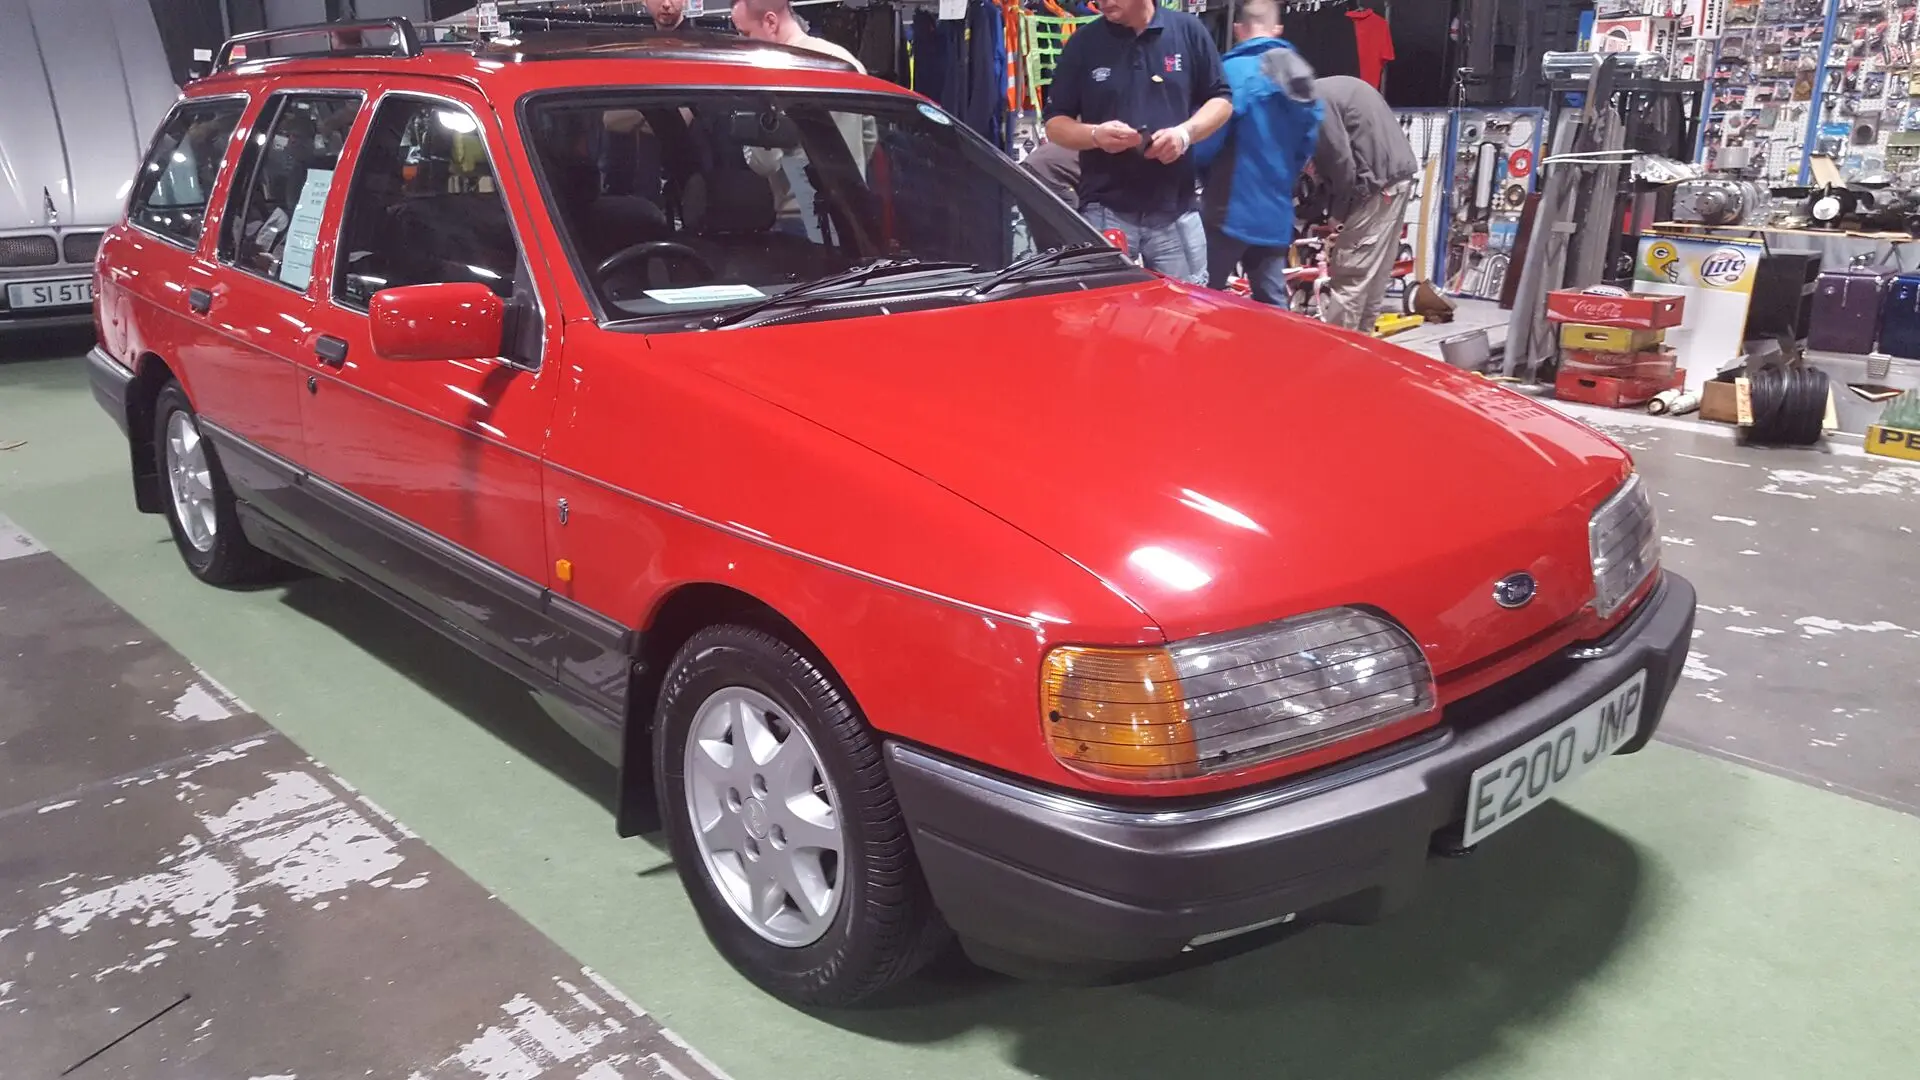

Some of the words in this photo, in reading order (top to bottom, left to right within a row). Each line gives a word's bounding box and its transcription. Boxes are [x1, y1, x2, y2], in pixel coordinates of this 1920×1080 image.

[1655, 29, 1667, 53] lley
[1702, 259, 1746, 277] Lite
[1471, 727, 1576, 834] E200
[1582, 682, 1641, 764] JNP
